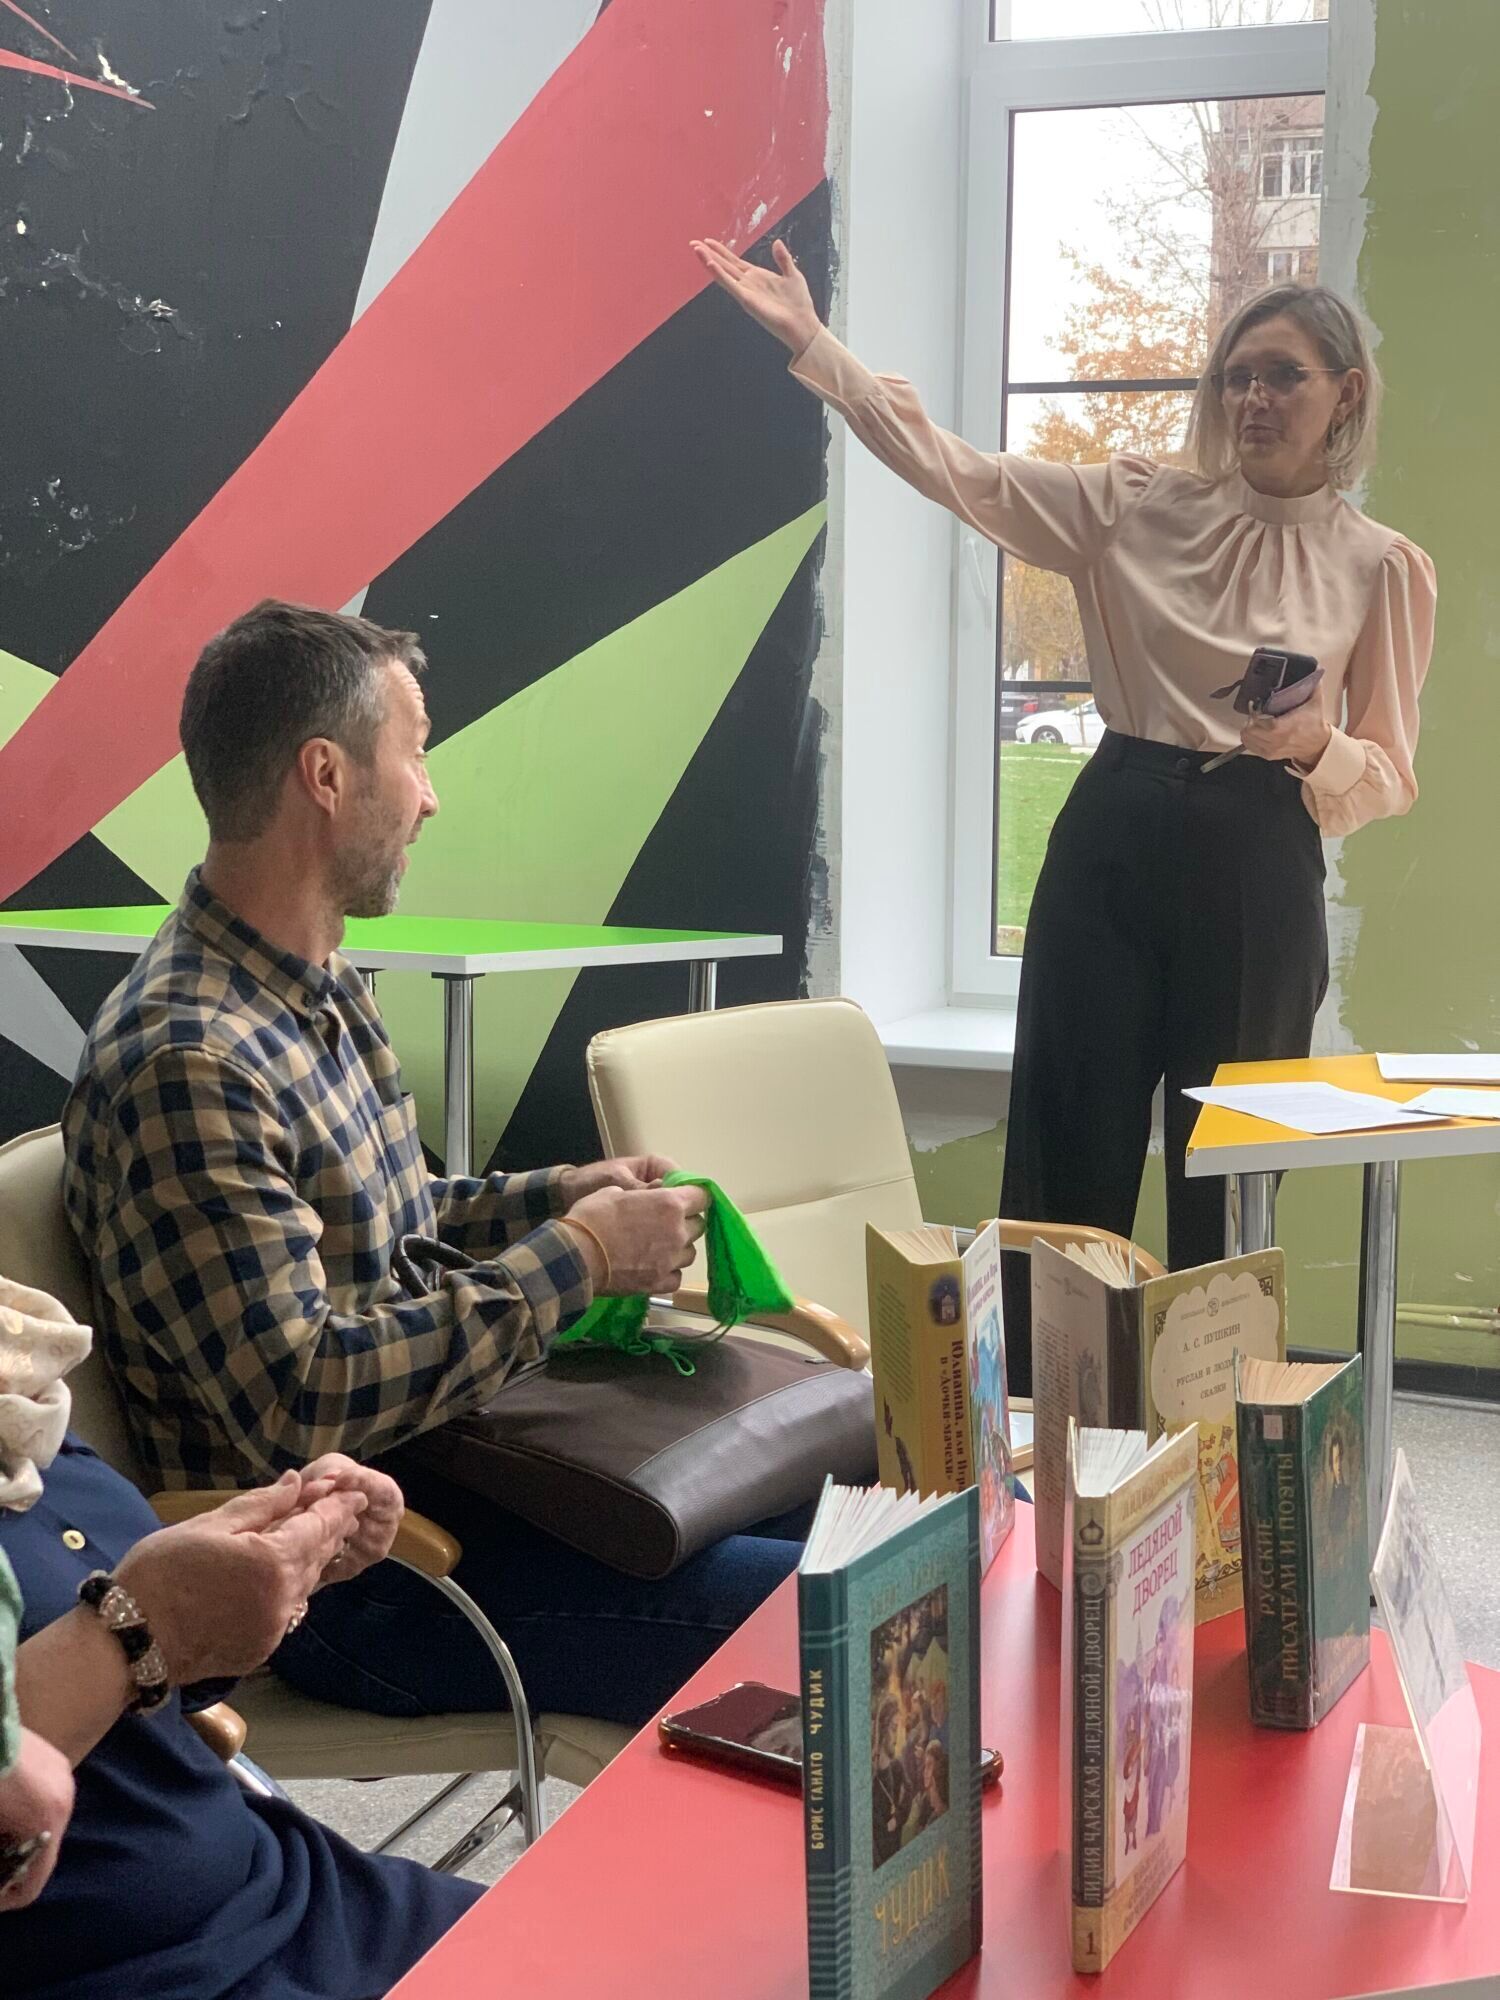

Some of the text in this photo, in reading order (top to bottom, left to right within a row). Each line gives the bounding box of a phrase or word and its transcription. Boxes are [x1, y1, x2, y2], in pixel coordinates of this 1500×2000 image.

[940, 1356, 948, 1364] в
[1176, 1353, 1247, 1388] РУСЛАН И ЛЮДМЛА
[1182, 1323, 1241, 1352] А. С. ПУШКИН
[952, 1340, 964, 1426] Юлианна,
[1200, 1382, 1227, 1400] СКАЗКИ
[956, 1430, 964, 1455] или
[1128, 1501, 1183, 1579] ЛЕДЯНОЙ
[1258, 1517, 1274, 1616] РУССКИЕ
[1278, 1453, 1298, 1681] ПИСАТЕЛИ И ПОЭТЫ
[1132, 1548, 1178, 1617] ДВОРЕЦ
[809, 1669, 824, 1850] БОРИС ГАНАГО ЧУДИК
[1080, 1599, 1103, 1904] ЛИДИЯ ЧАРСКАЯ ЛЕДЯНОЙ ДВОРЕЦ
[875, 1843, 951, 1953] ЧУДИК
[1086, 1932, 1098, 1955] 1
